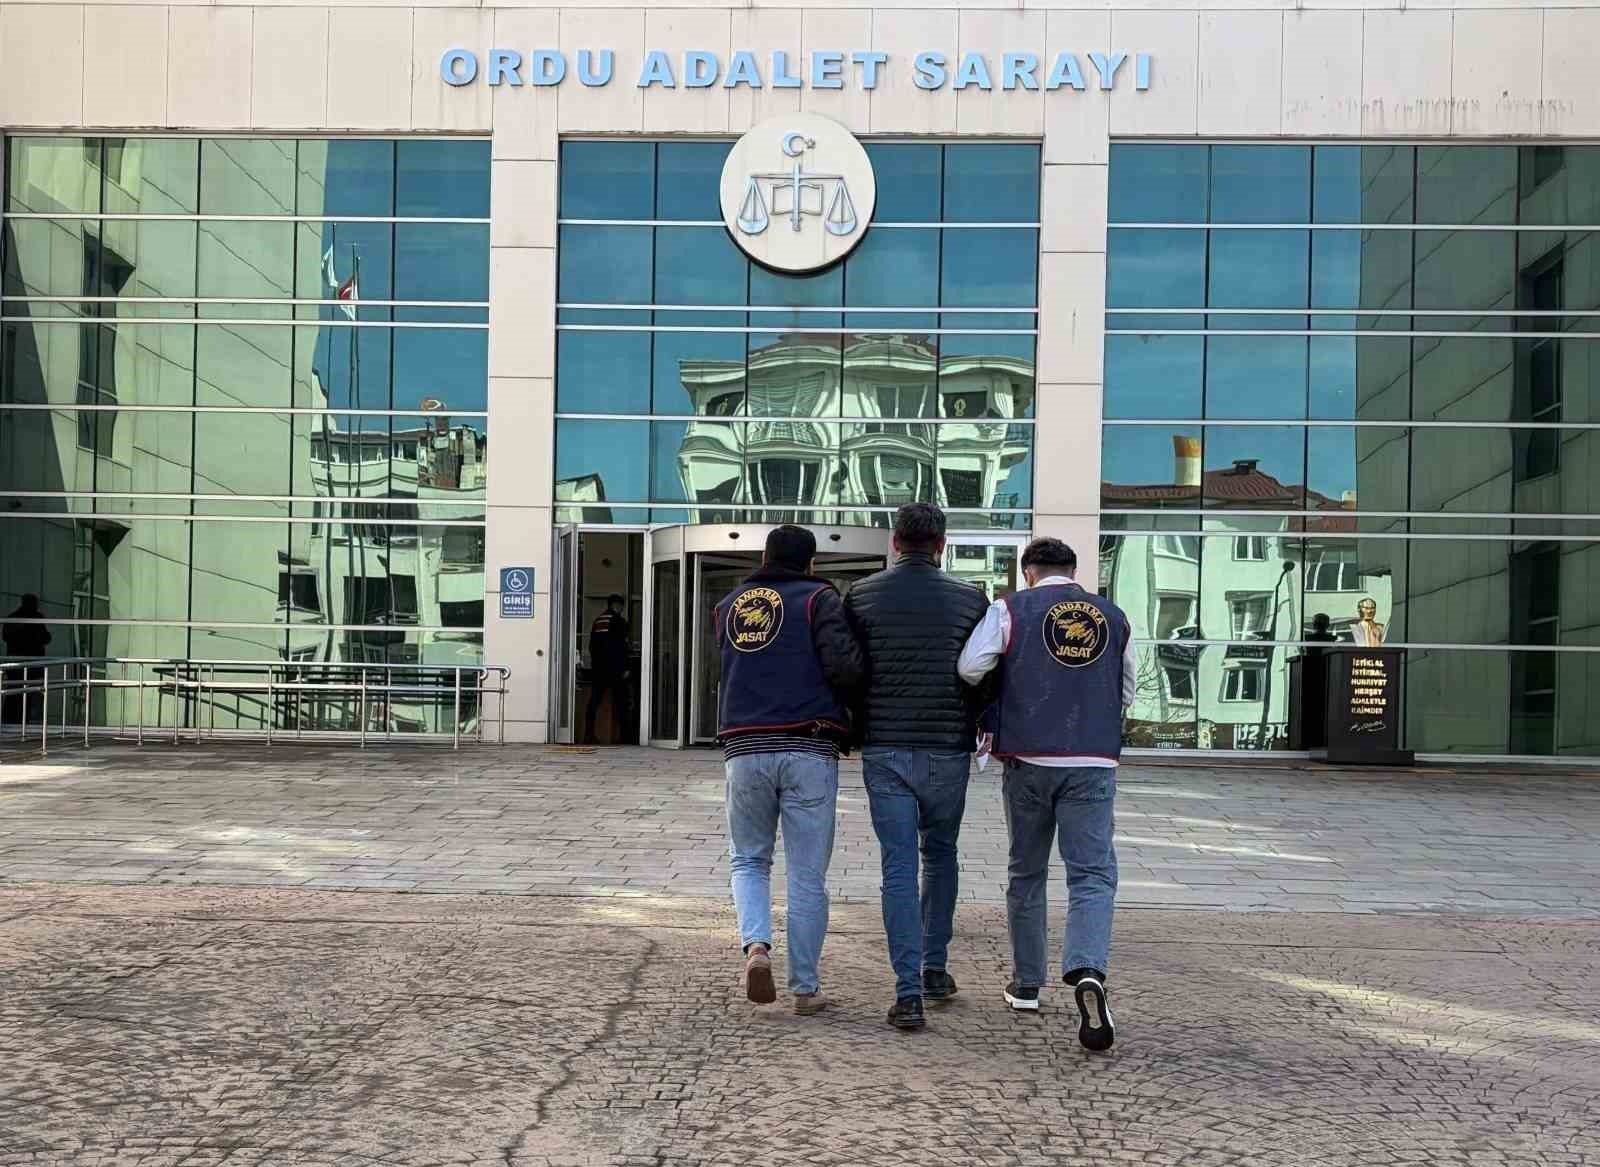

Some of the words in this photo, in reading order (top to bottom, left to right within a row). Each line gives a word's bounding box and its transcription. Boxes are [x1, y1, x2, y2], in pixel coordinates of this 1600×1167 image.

[440, 48, 613, 87] ORDU
[637, 50, 888, 90] ADALET
[912, 50, 1152, 92] SARAYI
[735, 589, 780, 613] JANDARMA
[1051, 603, 1103, 624] JANDARMA
[736, 632, 767, 643] JASAT
[1056, 645, 1091, 658] JASAT
